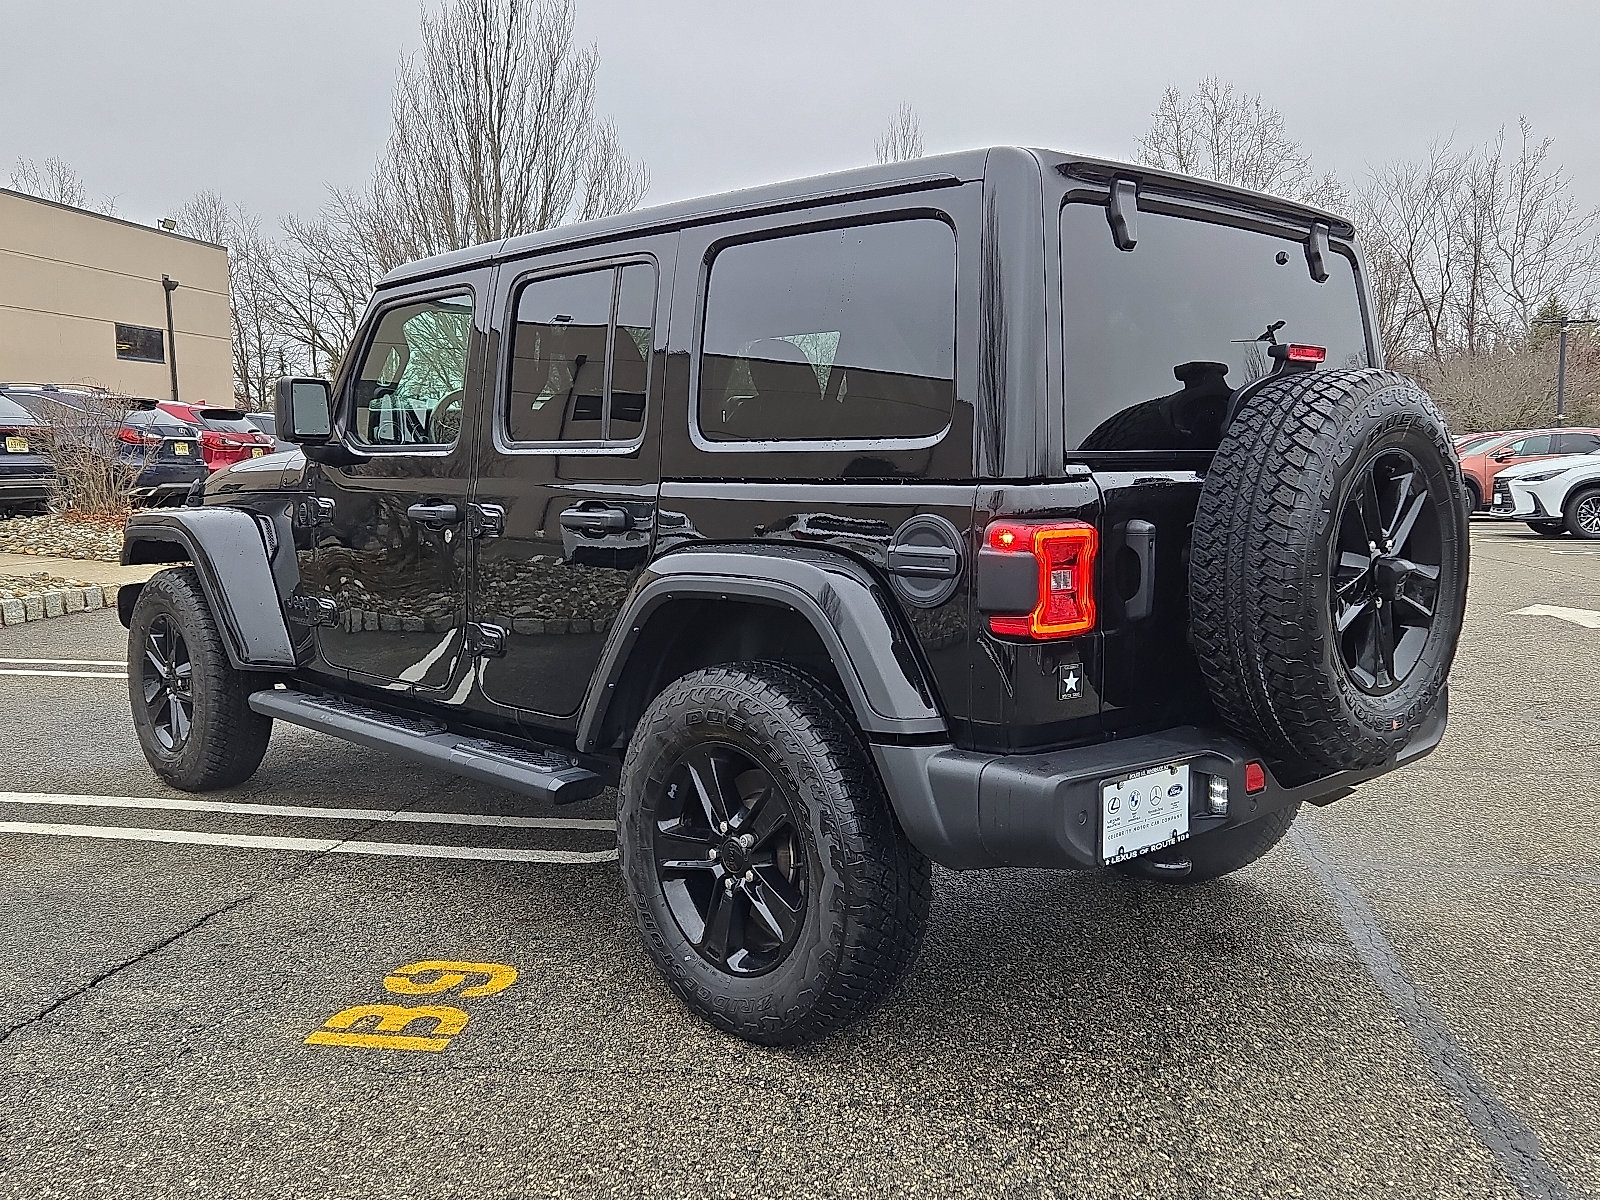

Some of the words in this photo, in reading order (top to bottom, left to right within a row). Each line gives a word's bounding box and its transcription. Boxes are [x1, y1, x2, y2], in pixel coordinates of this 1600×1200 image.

[685, 707, 799, 793] DUELER
[1111, 850, 1138, 864] LEXUS
[1139, 845, 1150, 855] OF
[1150, 838, 1176, 853] ROUTE
[1177, 834, 1185, 843] 10
[1151, 819, 1160, 828] CAR
[635, 893, 773, 1014] BRIDGESTONE
[303, 960, 519, 1051] B9
